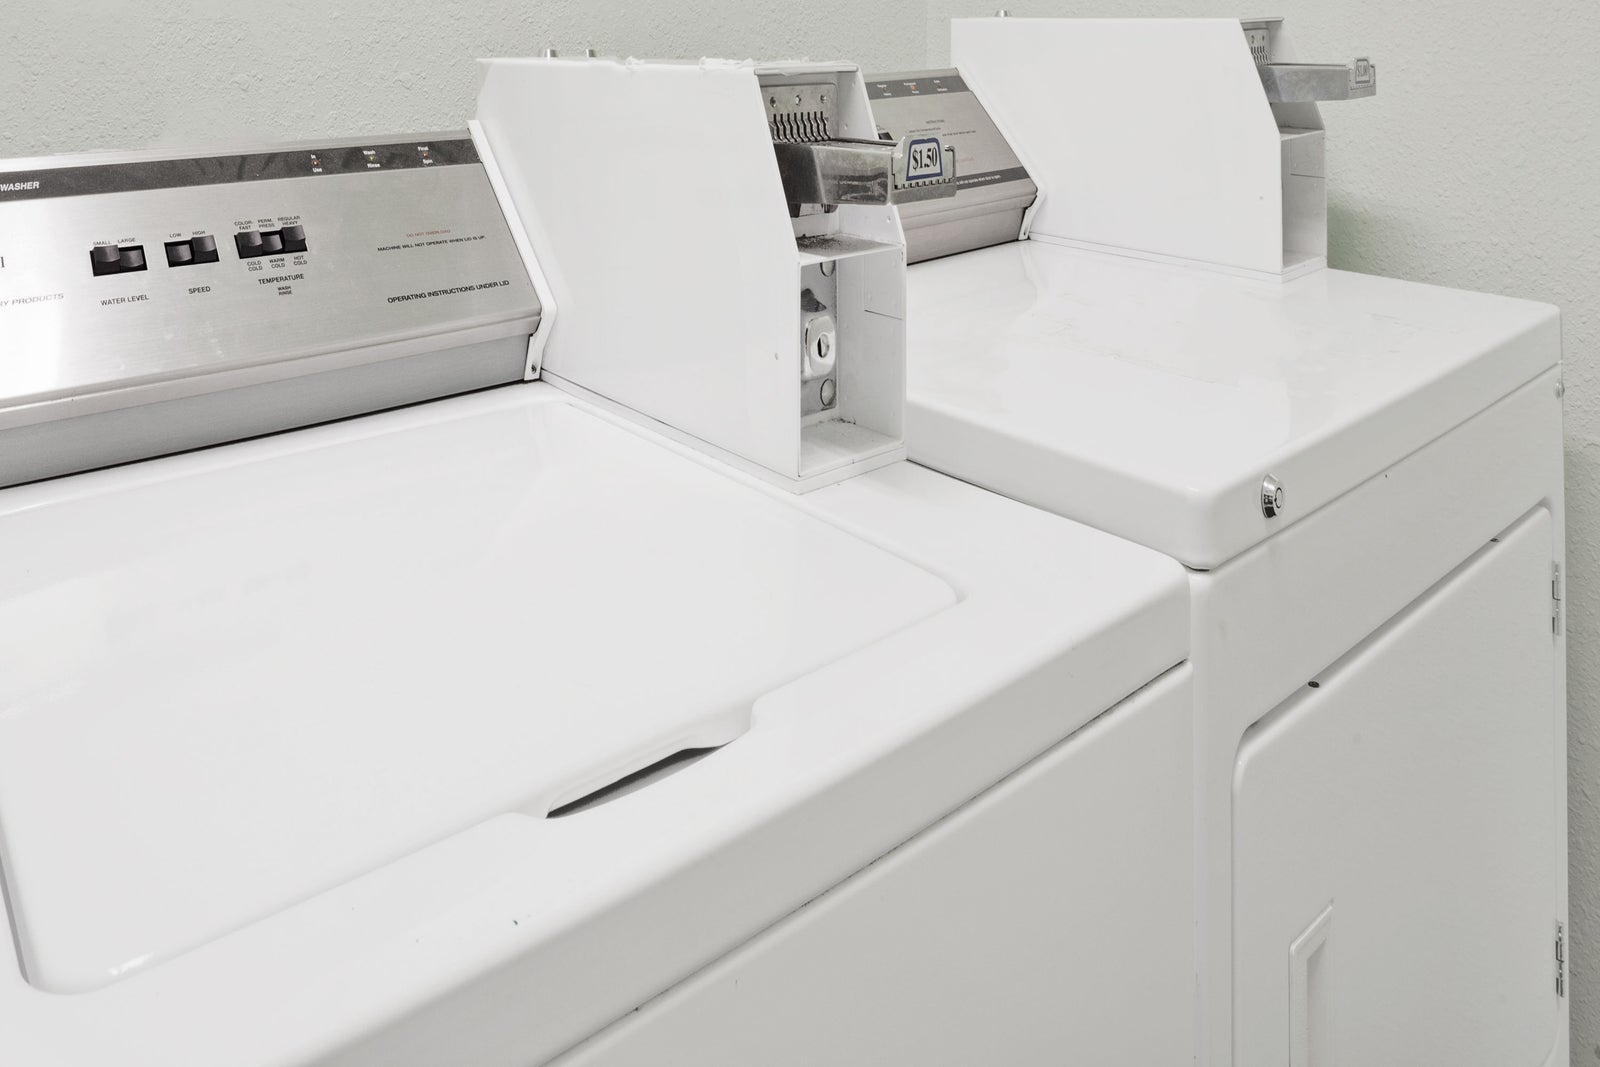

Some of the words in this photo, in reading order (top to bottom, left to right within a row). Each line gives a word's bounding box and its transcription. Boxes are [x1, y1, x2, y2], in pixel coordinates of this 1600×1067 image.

[912, 146, 938, 172] $1.50
[0, 181, 40, 192] WASHER
[258, 273, 304, 285] TEMPERATURE
[188, 286, 211, 294] SPEED
[387, 292, 427, 303] OPERATING
[428, 285, 475, 297] INSTRUCTIONS
[12, 293, 64, 305] PRODUCTS
[100, 296, 126, 306] WATER
[127, 294, 149, 303] LEVEL
